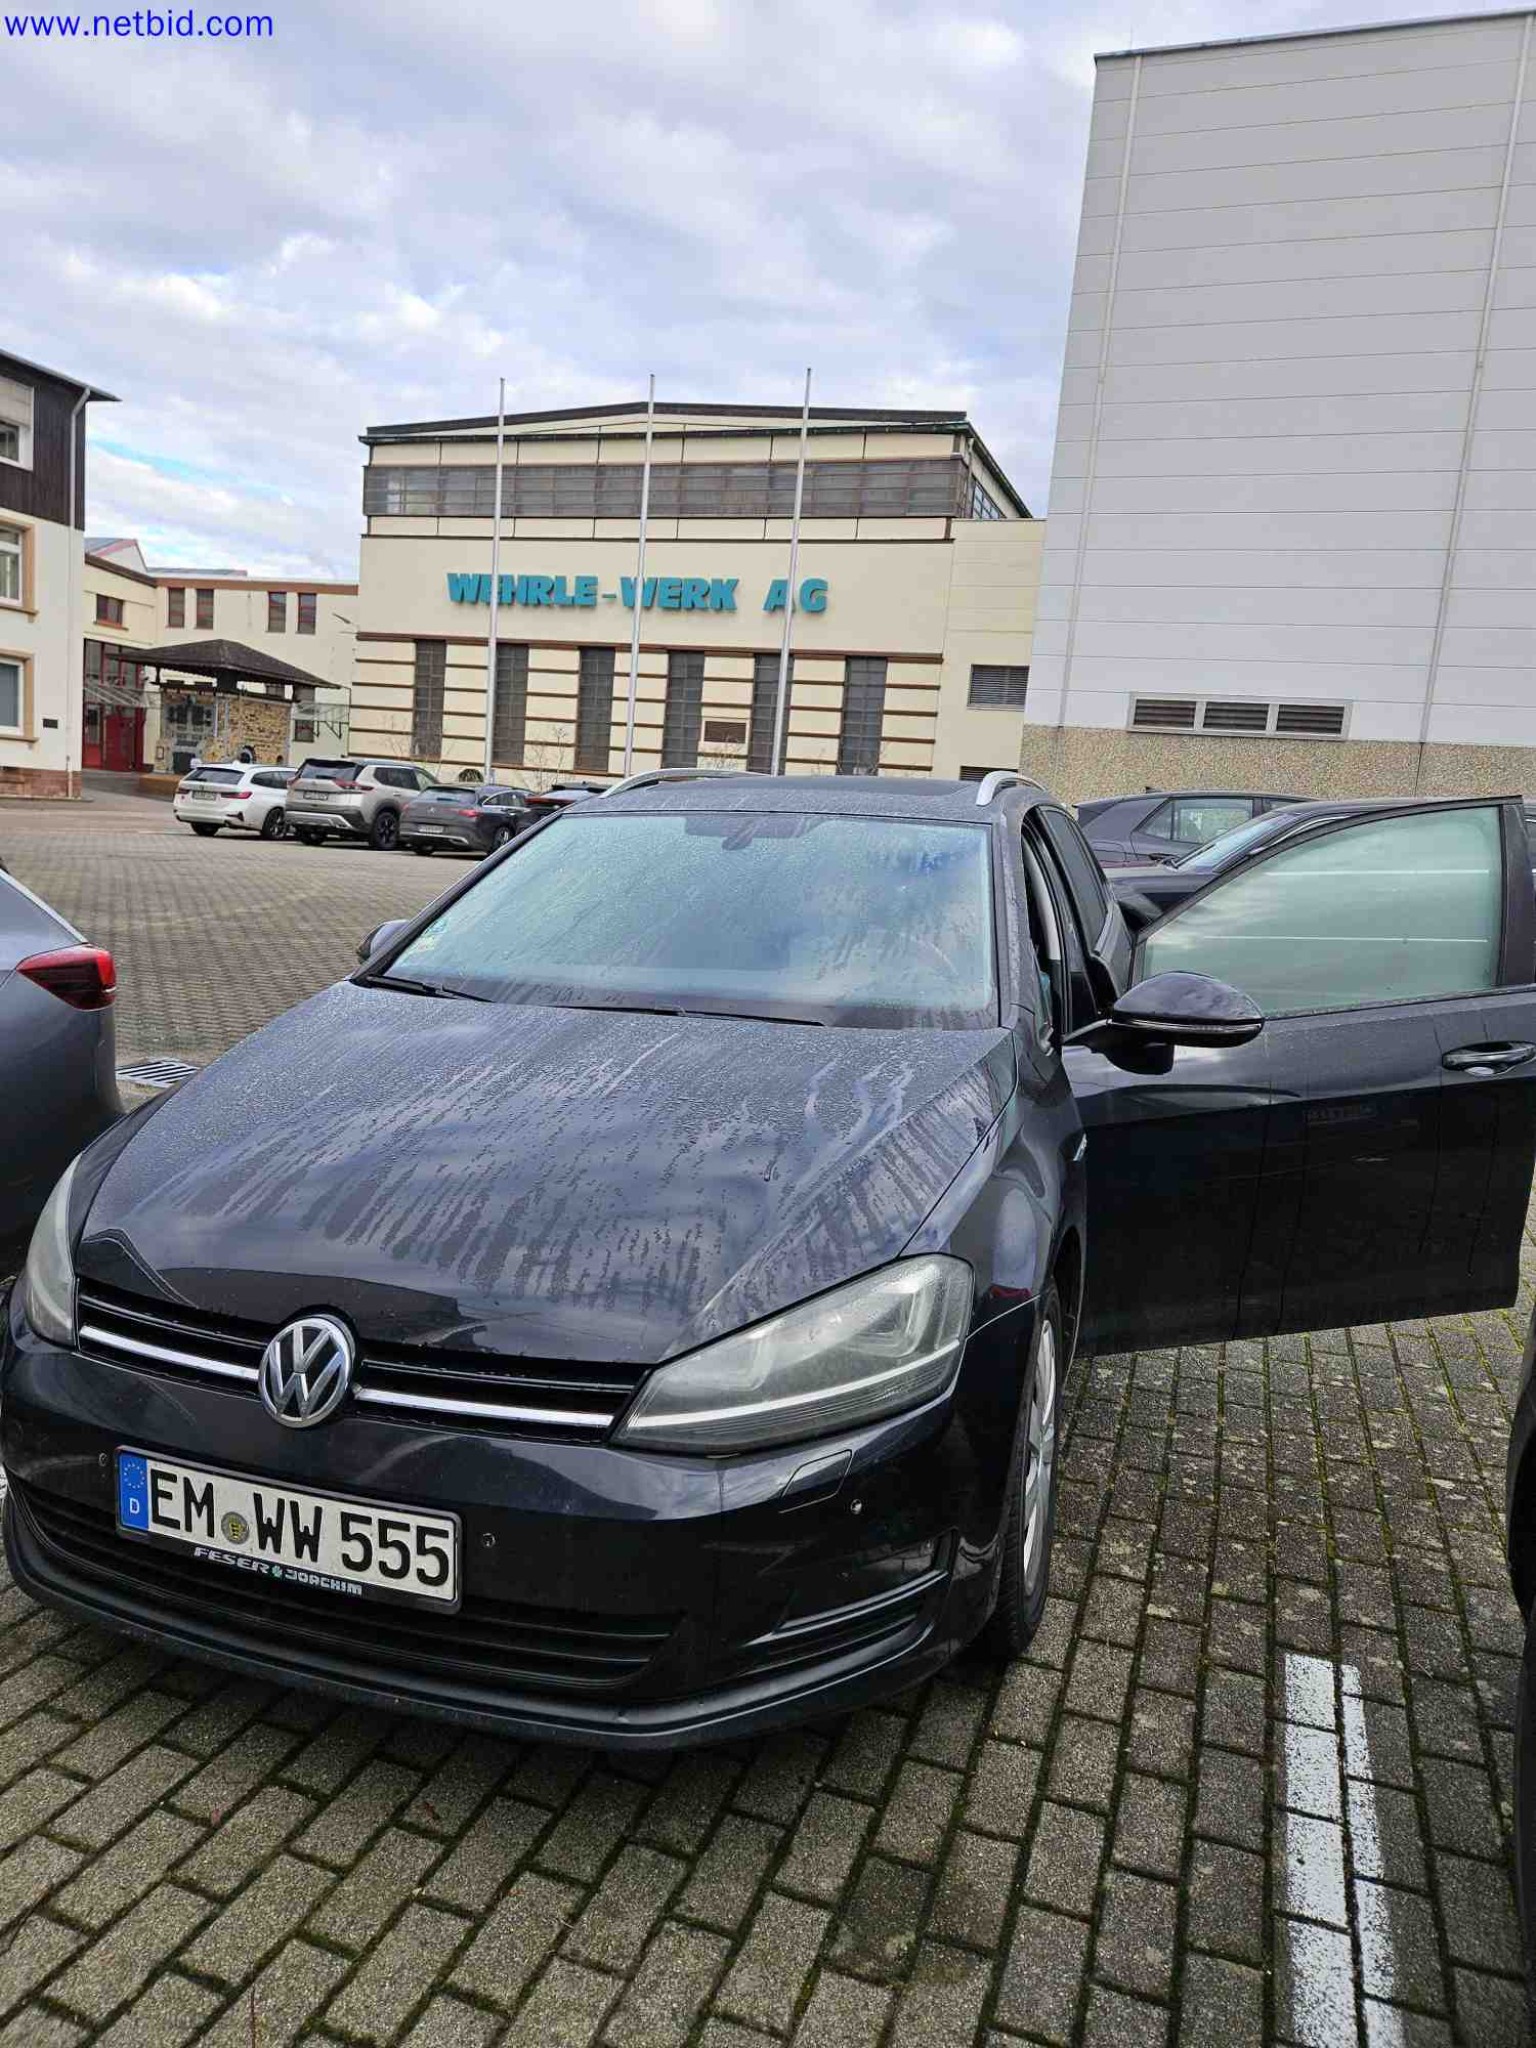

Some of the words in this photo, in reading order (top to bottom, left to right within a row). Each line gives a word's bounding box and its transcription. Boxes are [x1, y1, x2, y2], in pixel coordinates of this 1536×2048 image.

[447, 572, 740, 612] WEHRLE-WERK
[763, 577, 829, 613] AG
[129, 1497, 140, 1514] D
[150, 1468, 215, 1539] EM
[253, 1492, 323, 1563] WW
[340, 1511, 450, 1587] 555
[193, 1546, 270, 1575] FESER
[285, 1569, 363, 1596] JOACHIM
